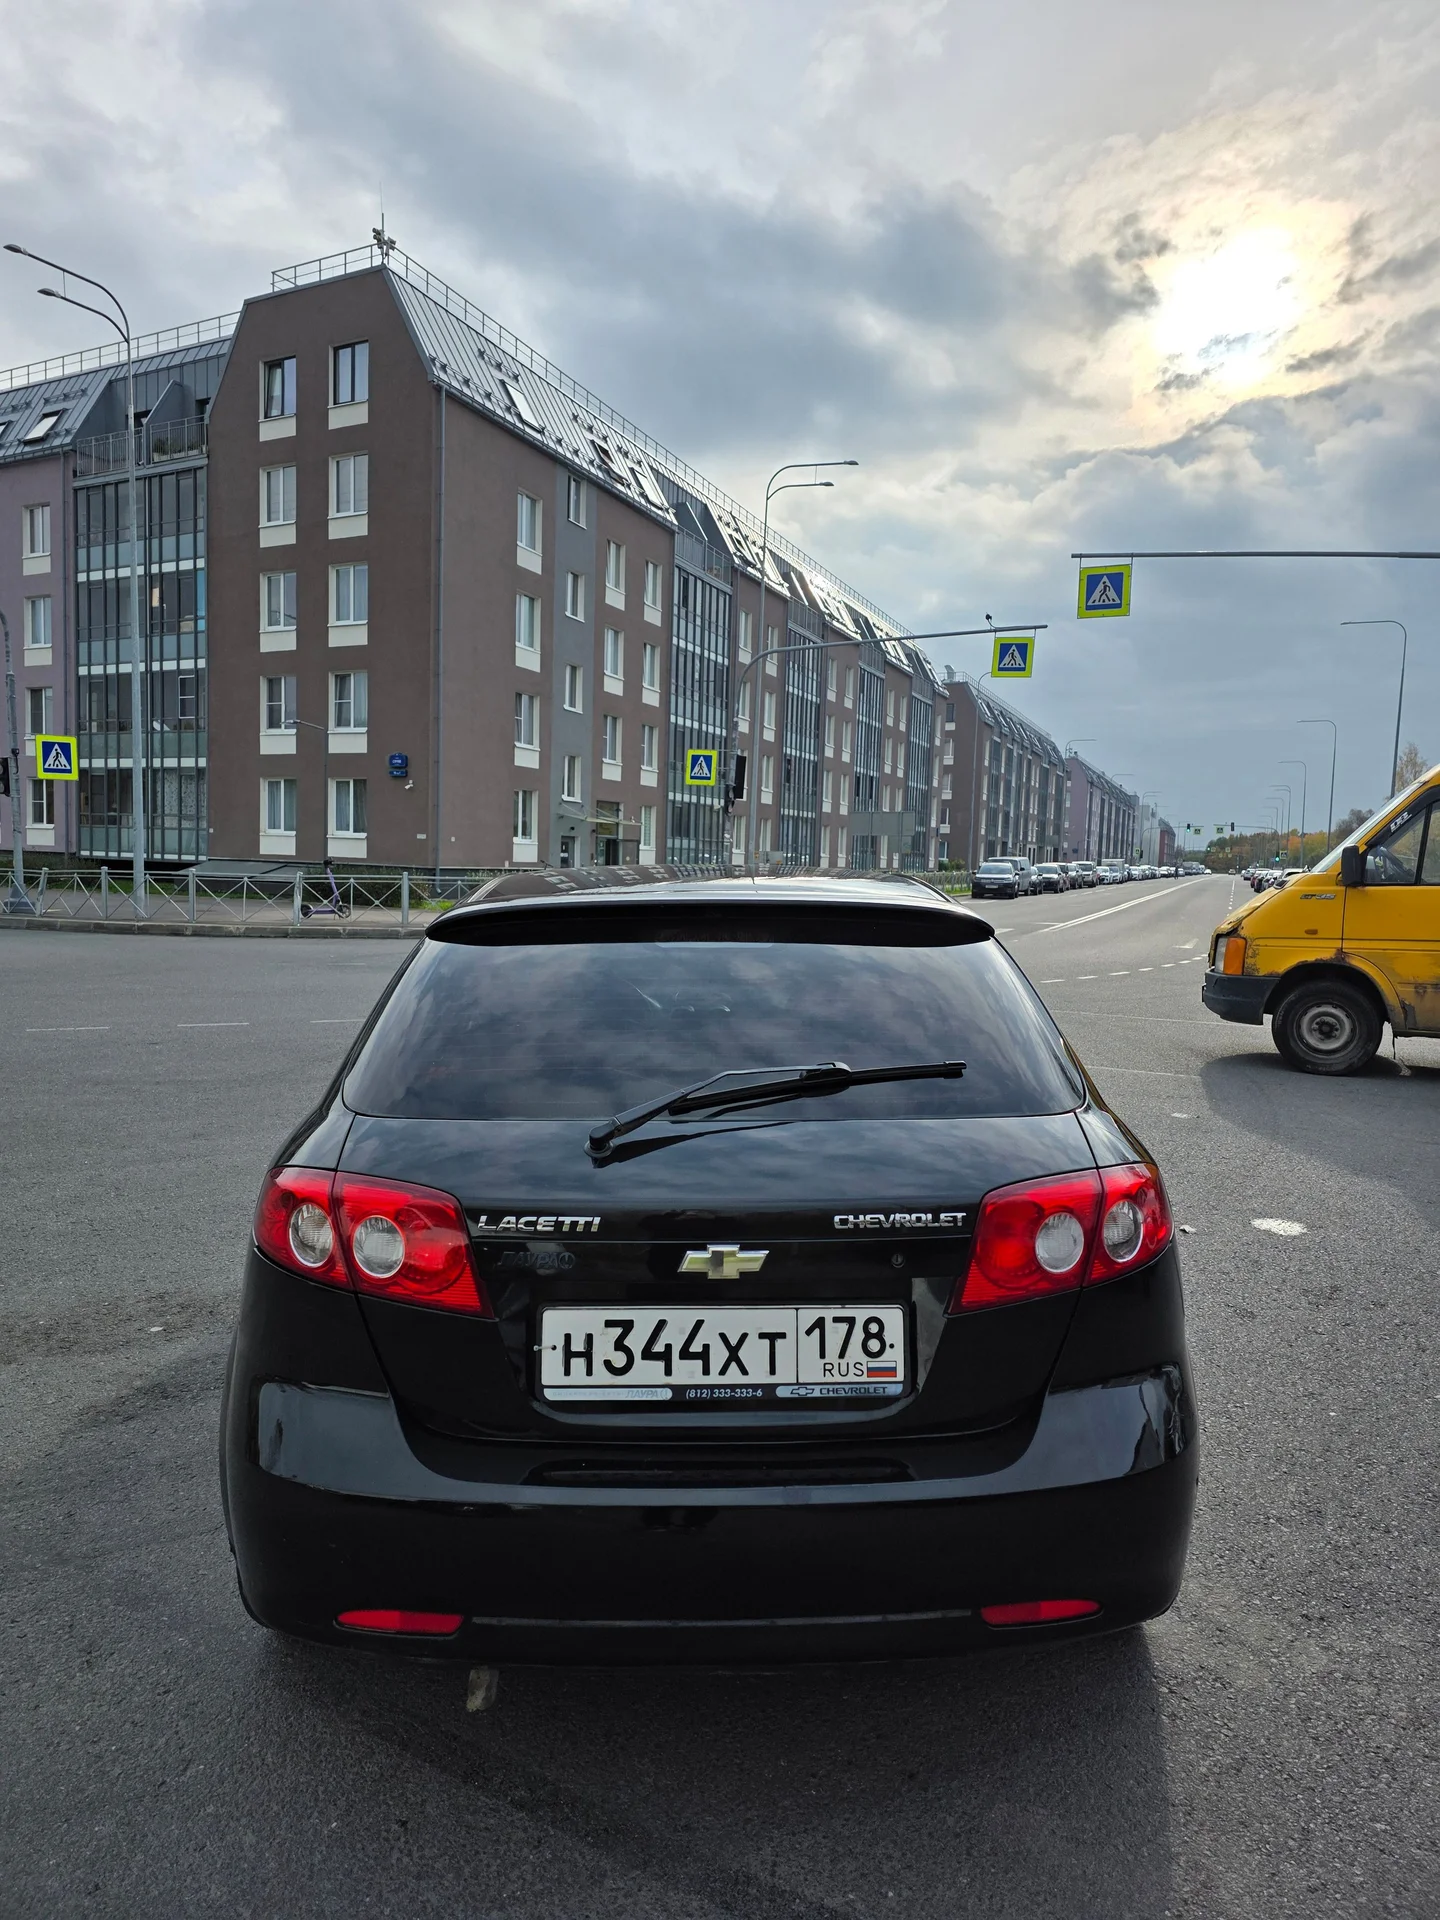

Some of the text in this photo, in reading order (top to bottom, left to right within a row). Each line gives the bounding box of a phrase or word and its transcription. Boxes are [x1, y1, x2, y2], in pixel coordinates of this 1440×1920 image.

[477, 1214, 602, 1233] LACETTI
[833, 1211, 968, 1230] CHEVROLET
[804, 1316, 887, 1360] 178
[822, 1361, 865, 1378] RUS
[685, 1387, 763, 1400] (812) 333-333-6
[819, 1386, 888, 1396] CHEVROLET
